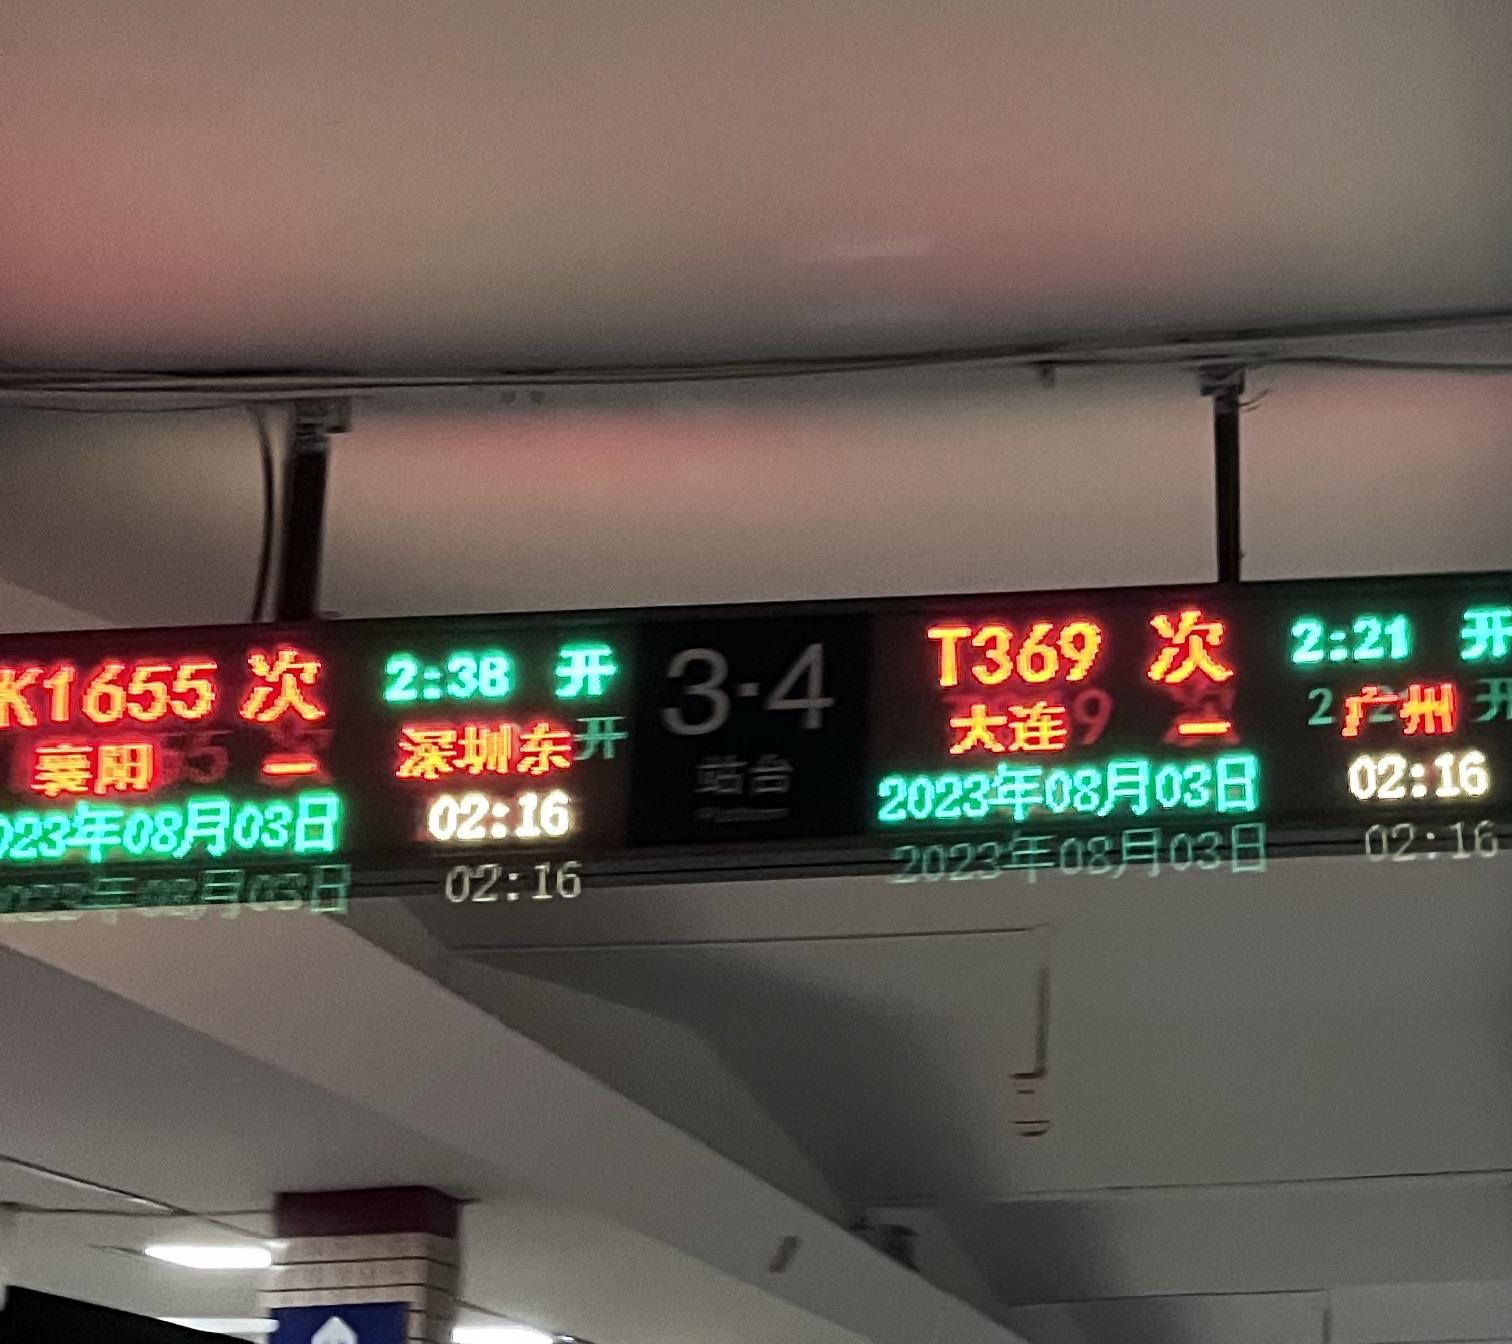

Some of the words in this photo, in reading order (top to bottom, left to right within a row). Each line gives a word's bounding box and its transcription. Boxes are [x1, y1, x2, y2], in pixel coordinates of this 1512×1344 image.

[926, 619, 1103, 688] T369
[1146, 609, 1235, 685] 次
[1290, 615, 1411, 666] 2:21
[0, 660, 219, 727] K1655
[239, 644, 327, 721] 次
[383, 652, 517, 703] 2:38
[554, 642, 618, 700] 开
[948, 702, 1069, 756] 大连
[1341, 683, 1459, 738] 广州
[395, 724, 574, 779] 深圳东
[1347, 751, 1491, 801] 02:16
[876, 752, 1261, 823] 2023年08月03日
[426, 791, 572, 843] 02:16
